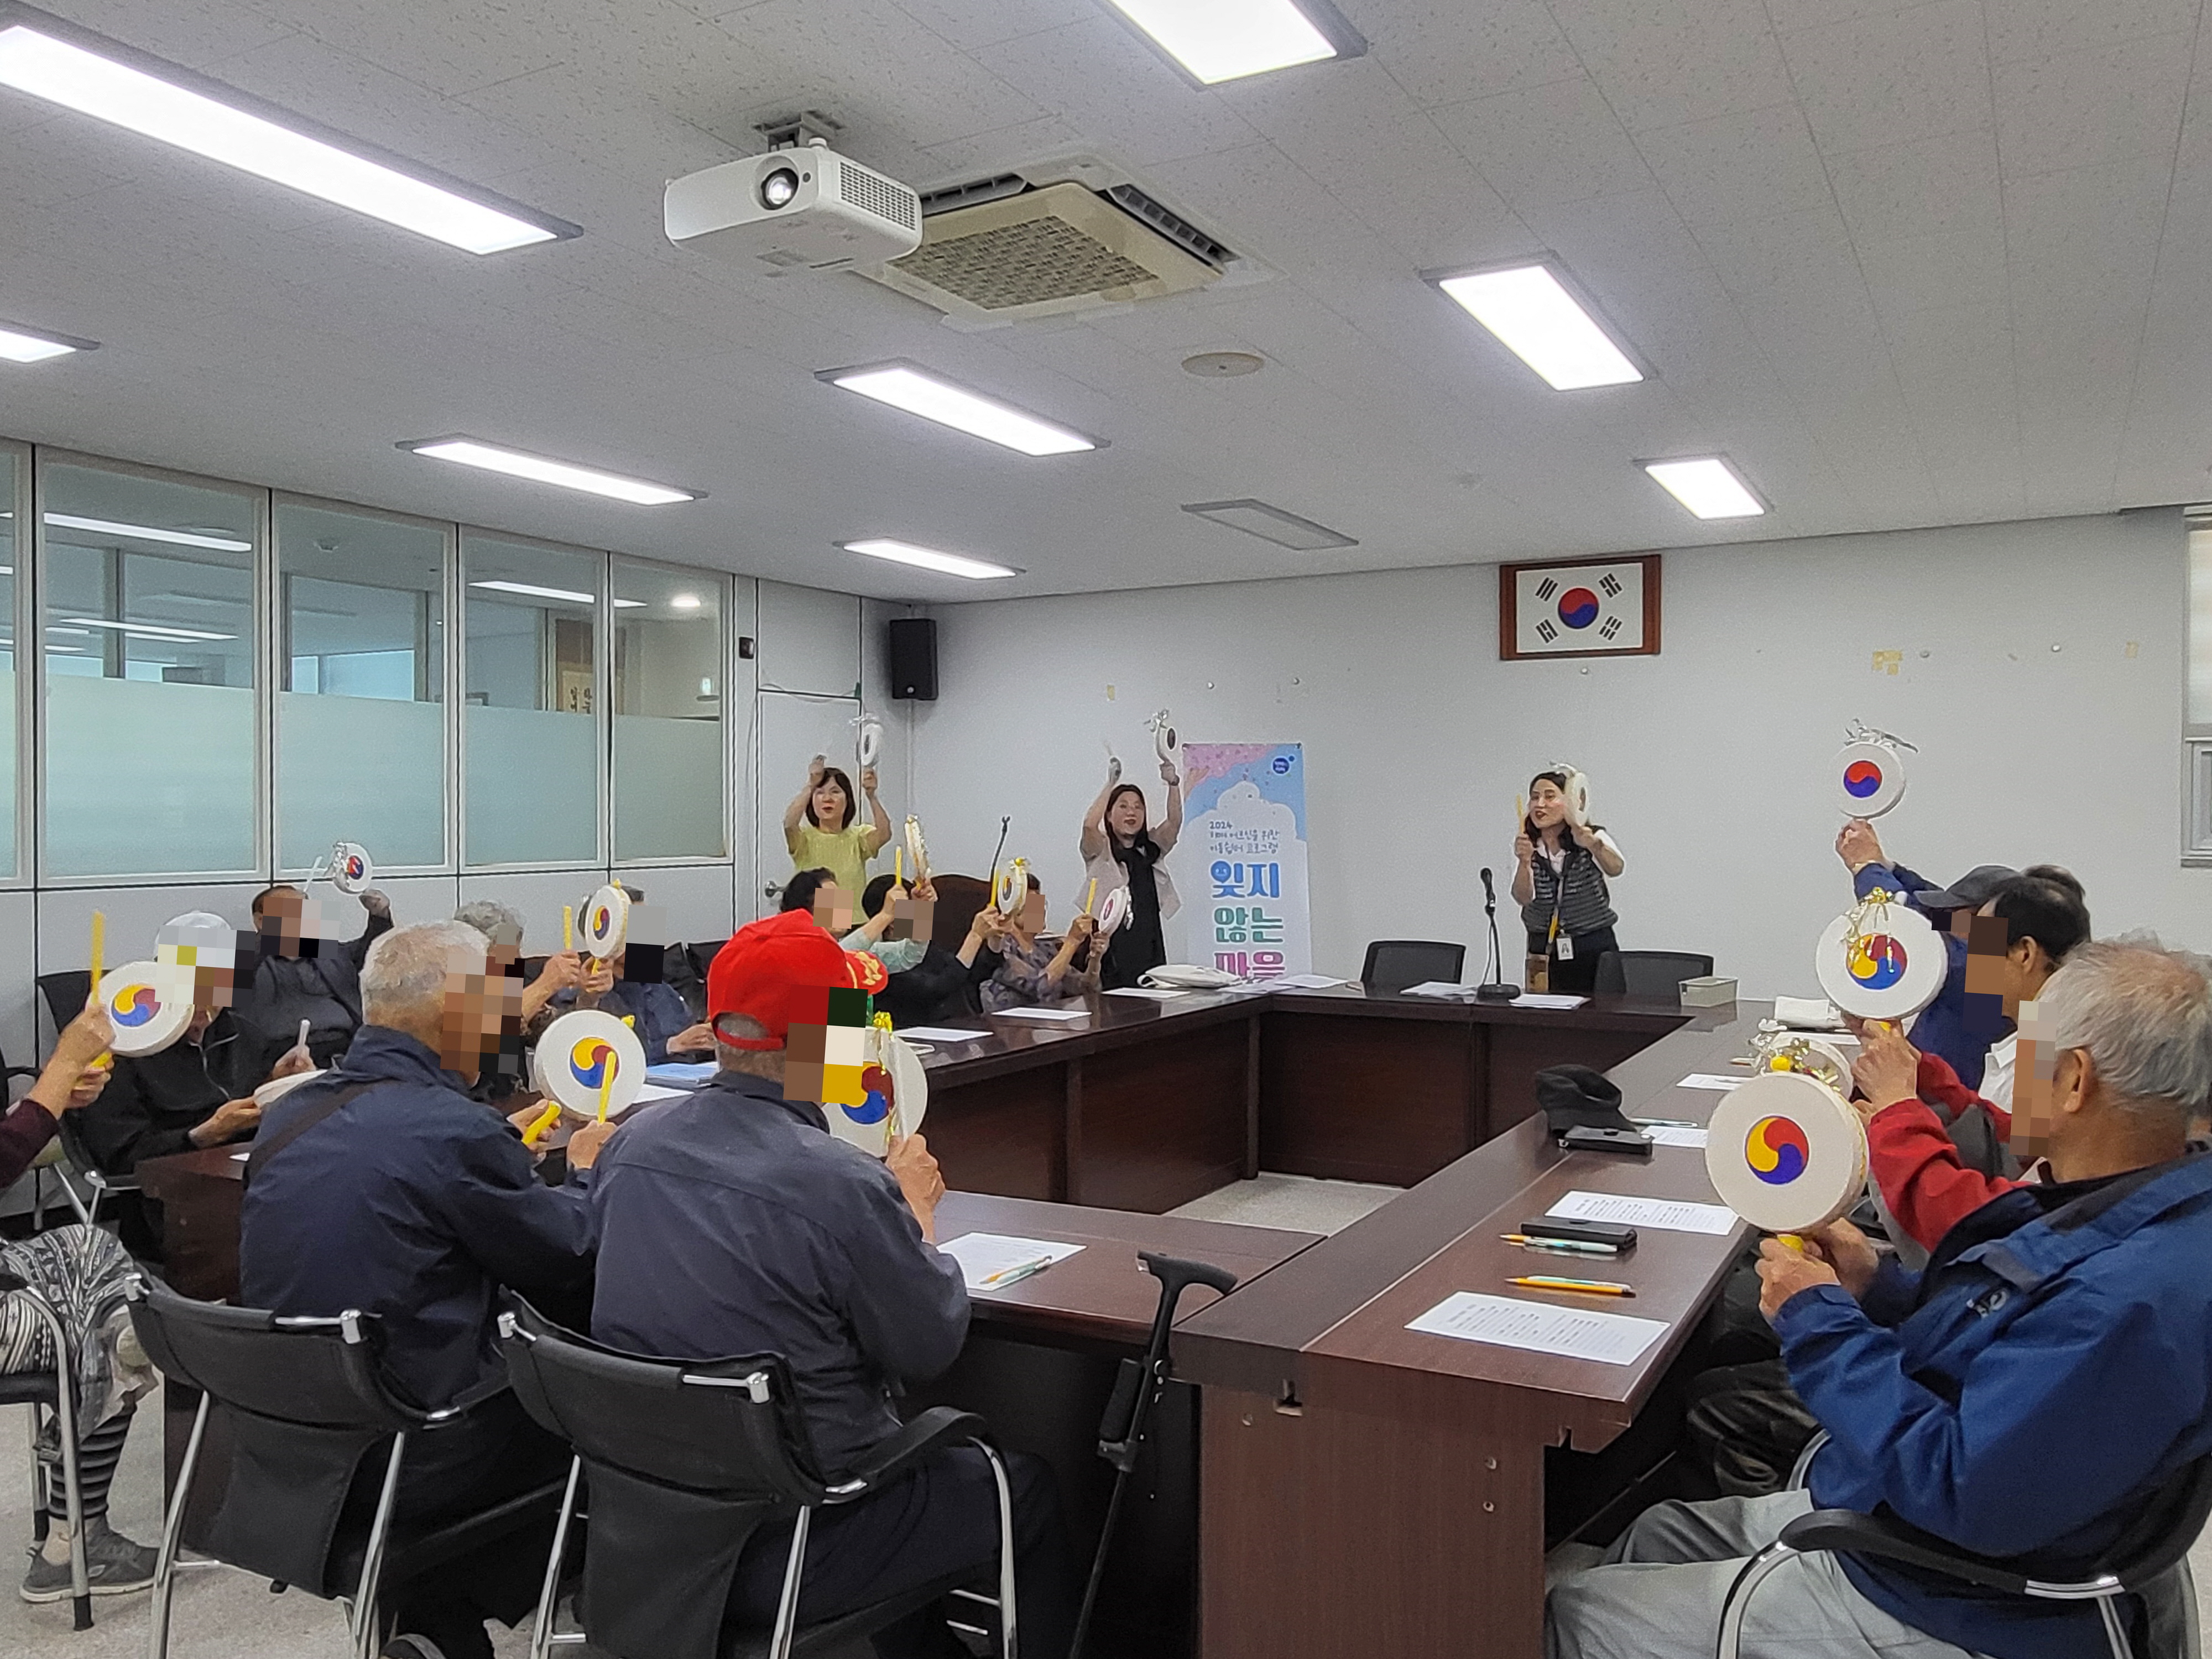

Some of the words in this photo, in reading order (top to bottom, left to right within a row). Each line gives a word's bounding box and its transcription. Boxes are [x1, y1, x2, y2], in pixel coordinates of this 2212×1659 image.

[1229, 830, 1258, 841] 어르신을
[1261, 830, 1280, 840] 위한
[1246, 842, 1278, 854] 프로그램
[1211, 860, 1280, 898] 잊지
[1214, 907, 1283, 942] 않는
